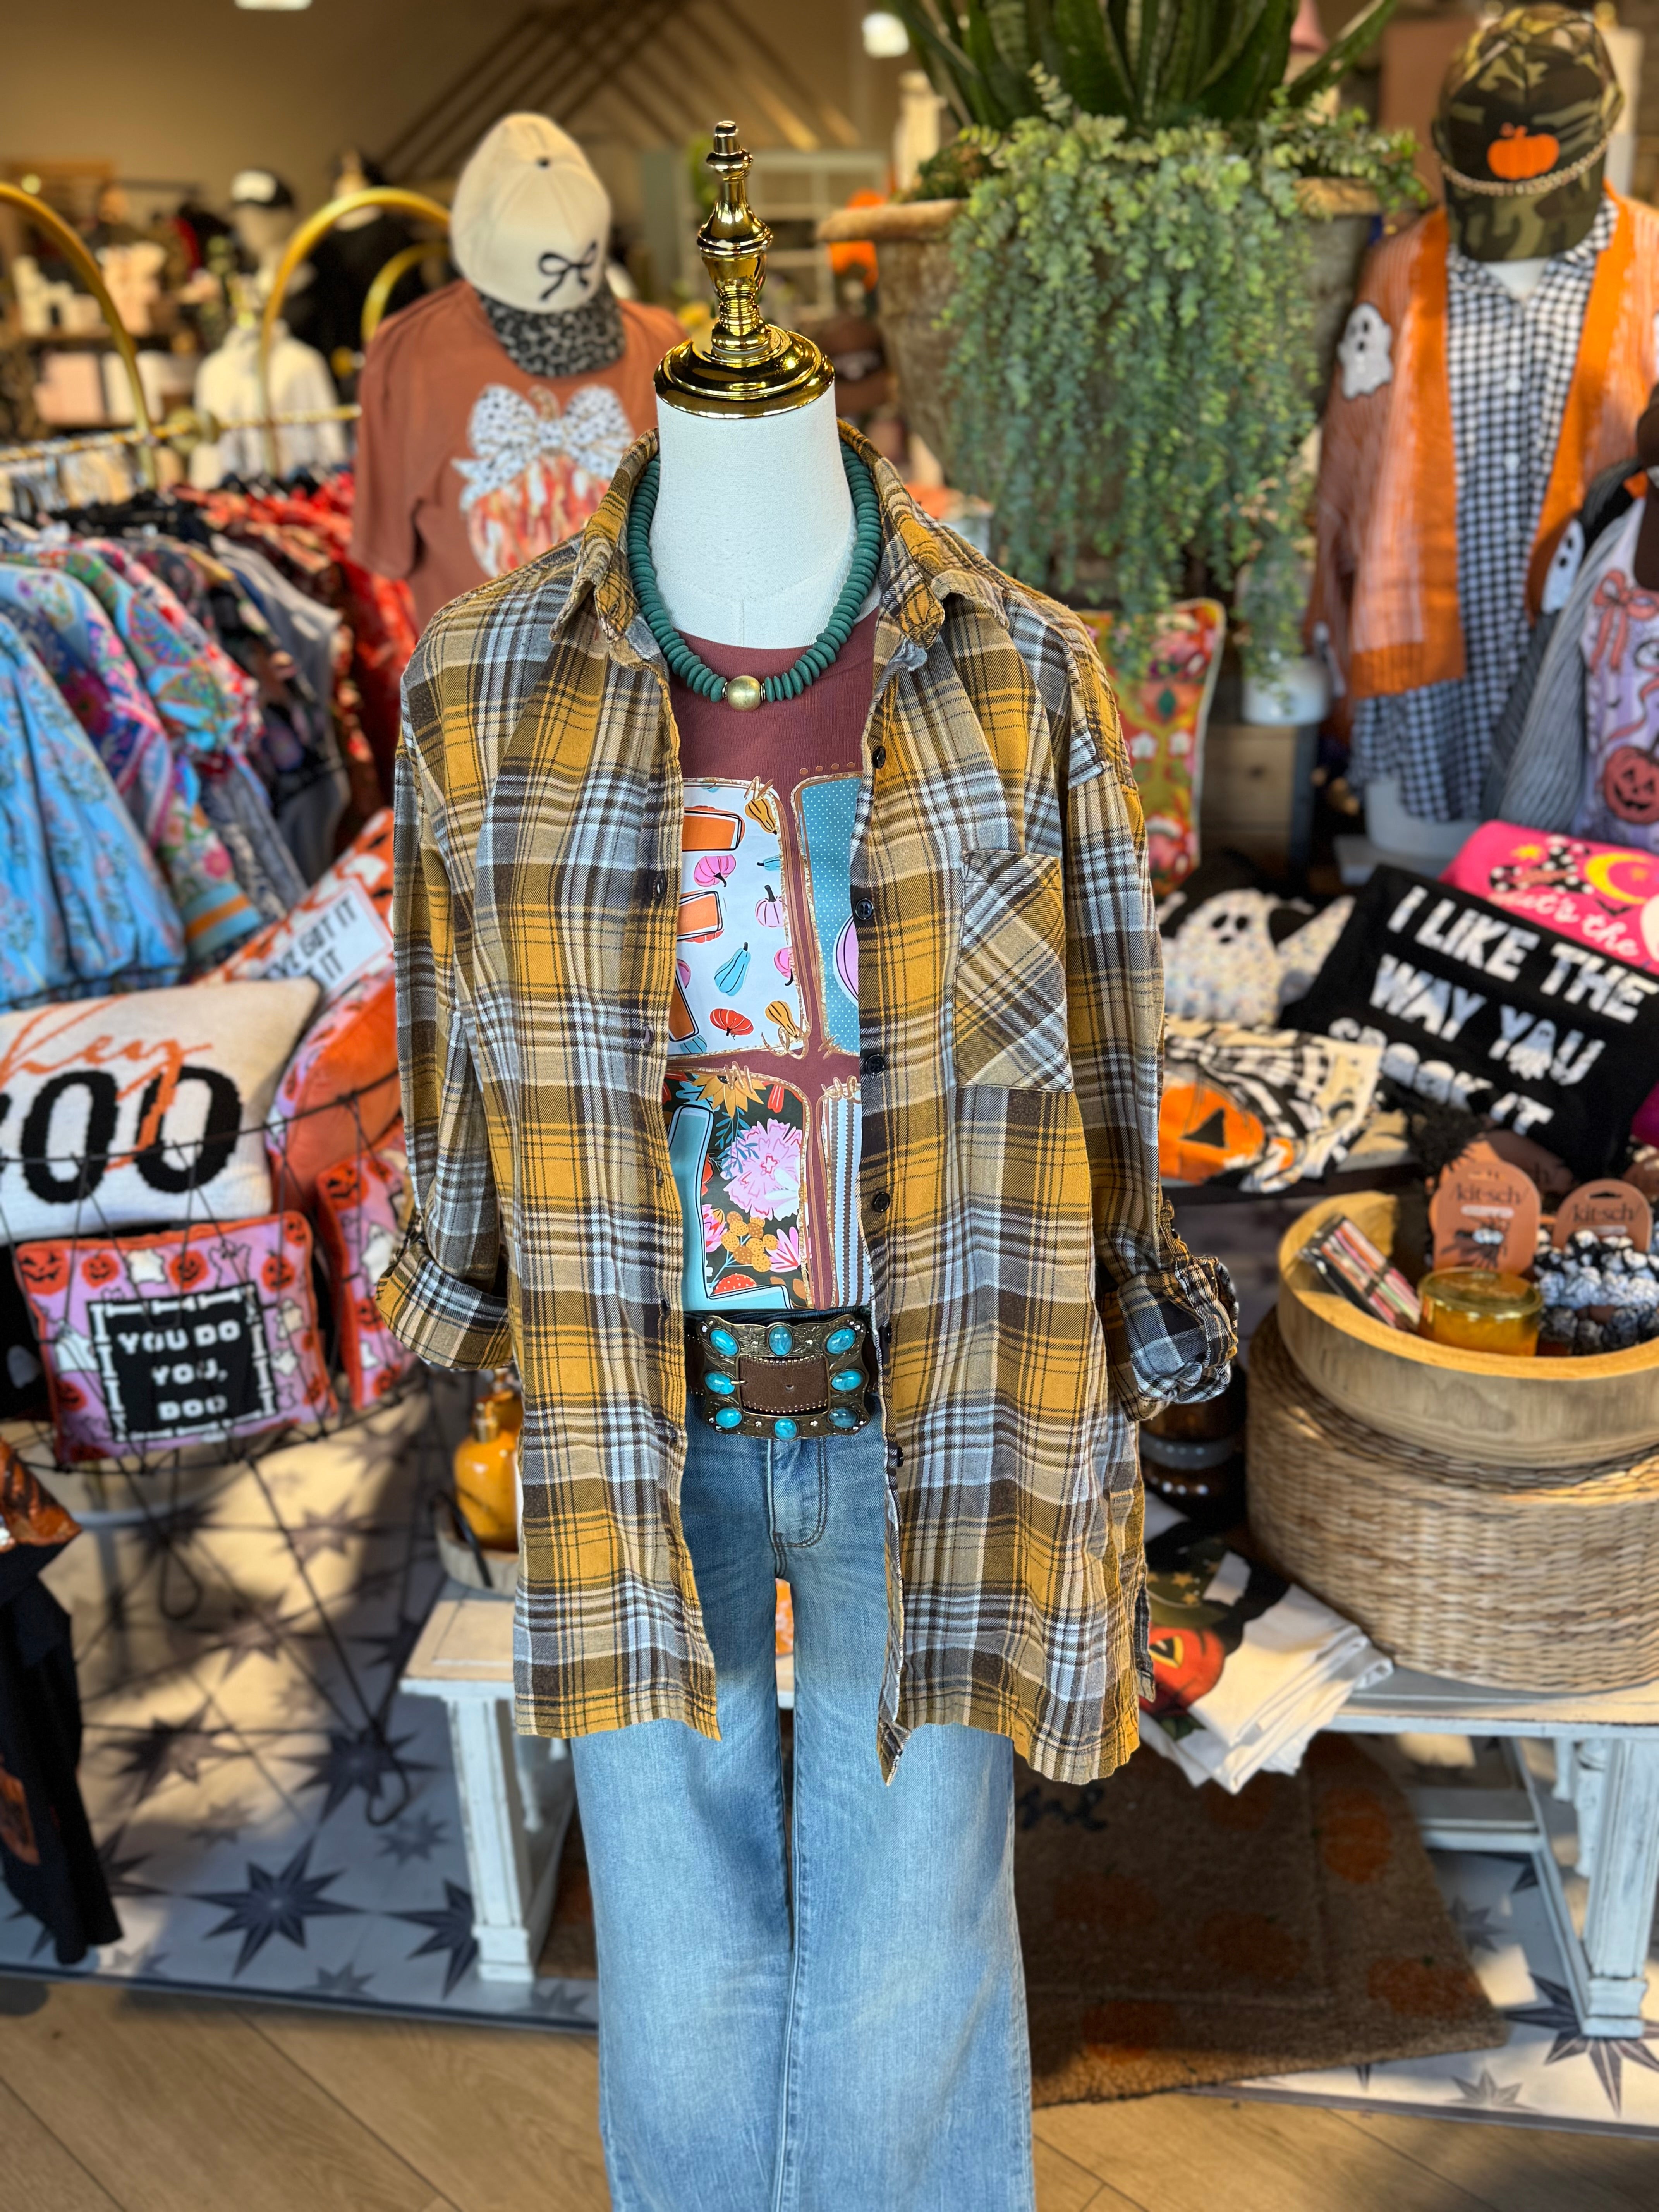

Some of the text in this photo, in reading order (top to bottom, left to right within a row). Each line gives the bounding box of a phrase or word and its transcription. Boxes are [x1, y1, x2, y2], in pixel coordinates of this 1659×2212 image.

[1369, 954, 1487, 1042] WAY
[1386, 885, 1659, 1024] I LIKE THE
[0, 1064, 242, 1206] OO
[117, 1318, 241, 1355] YOU DO
